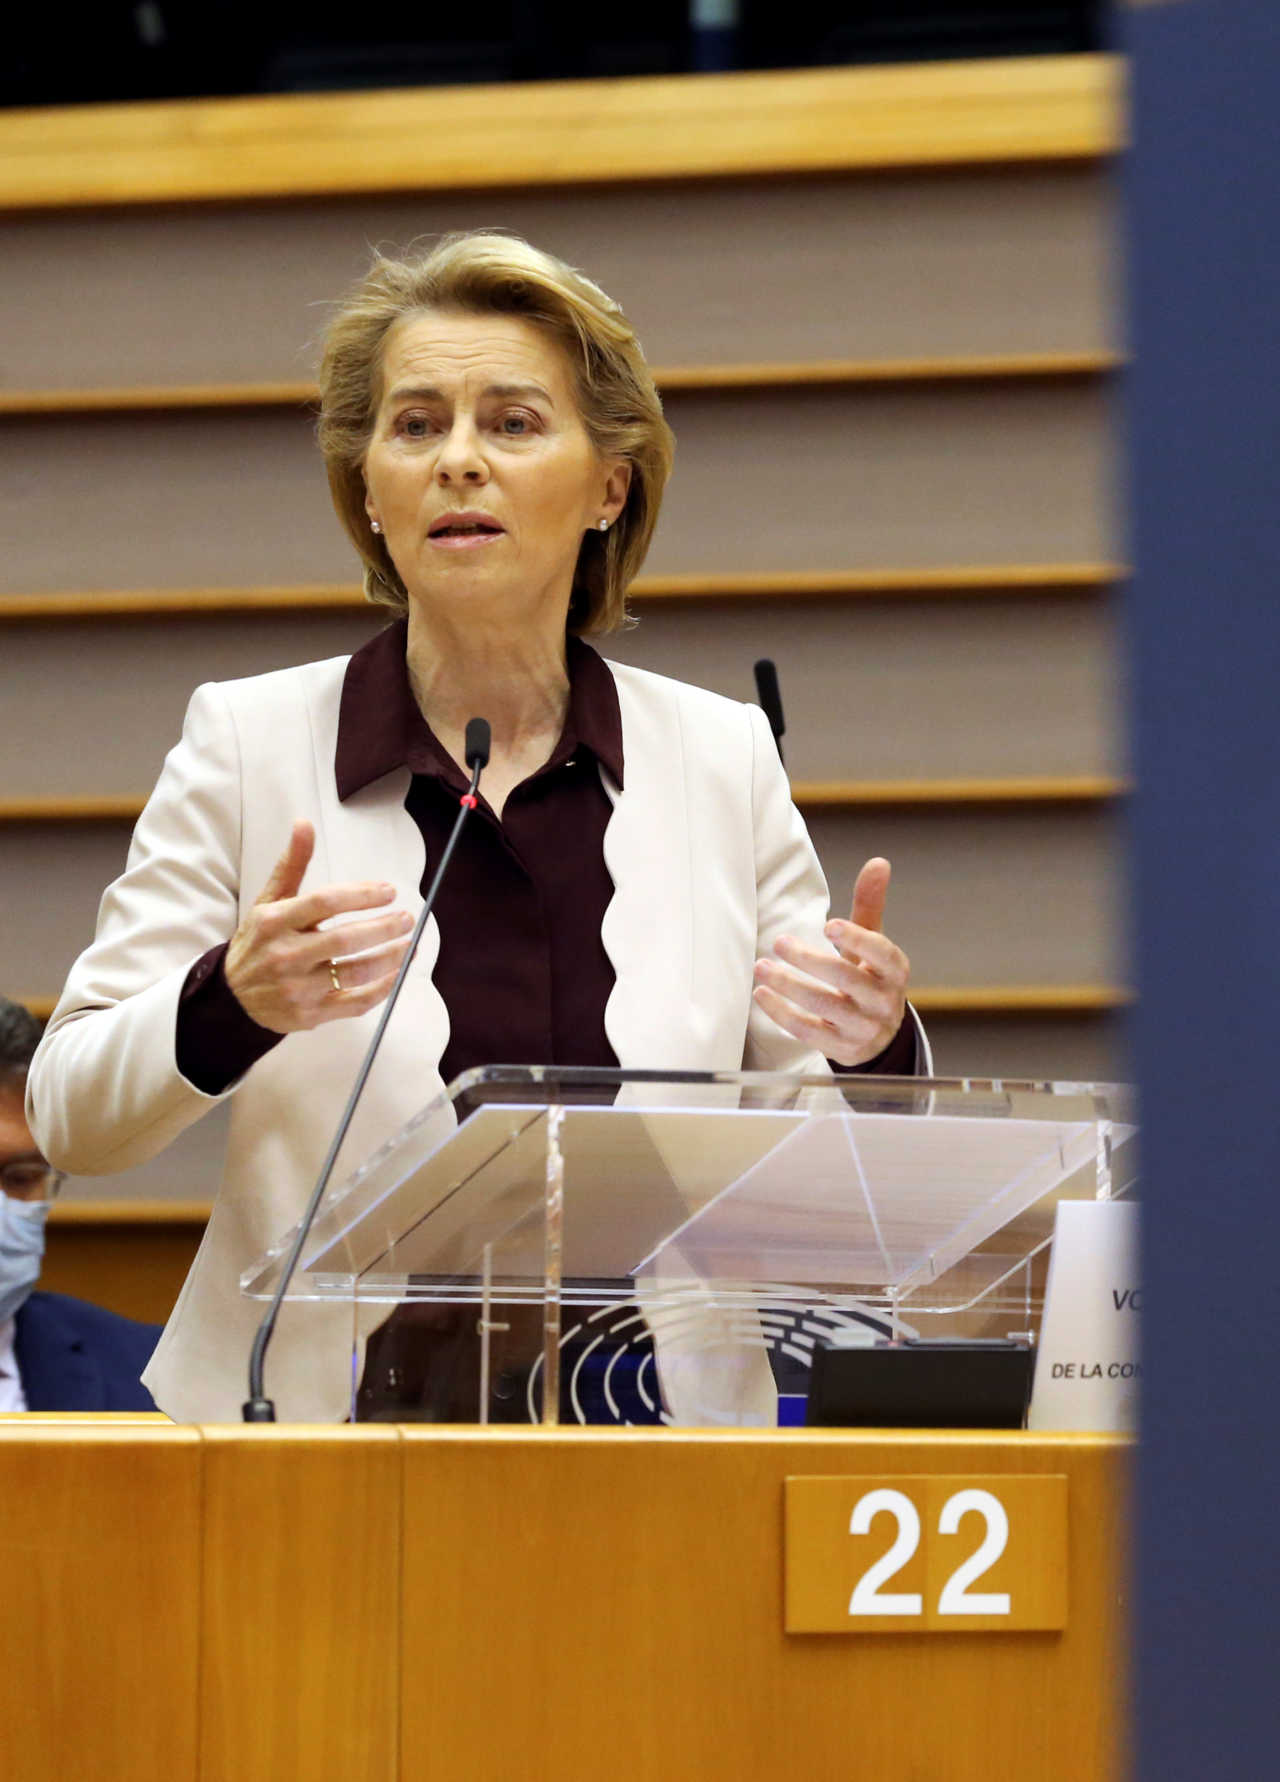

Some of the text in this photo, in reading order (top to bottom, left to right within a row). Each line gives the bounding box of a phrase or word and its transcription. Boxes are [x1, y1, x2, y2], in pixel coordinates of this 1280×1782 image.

[1052, 1363, 1075, 1378] DE
[1080, 1363, 1103, 1378] LA
[849, 1489, 1010, 1615] 22
